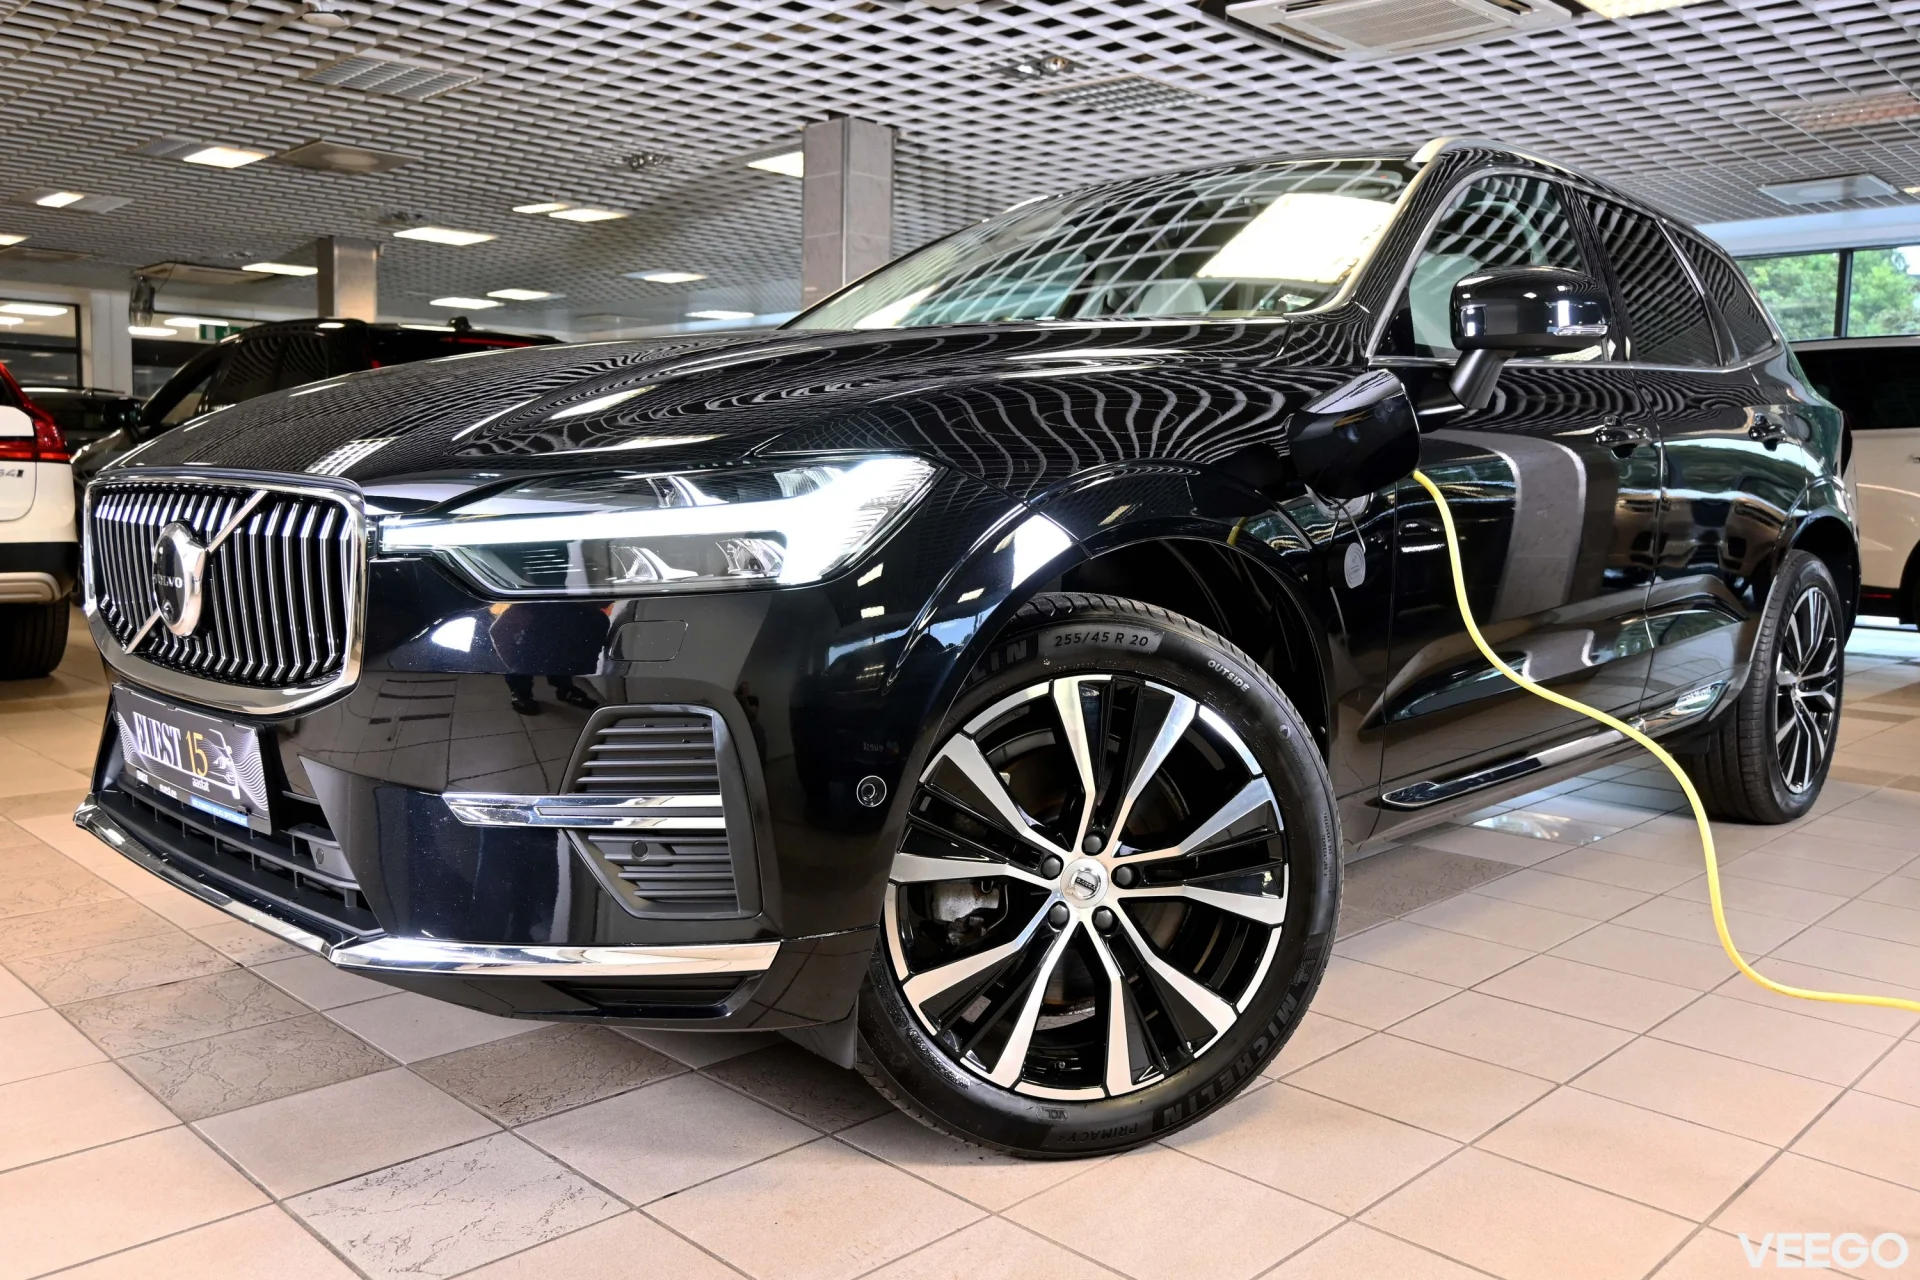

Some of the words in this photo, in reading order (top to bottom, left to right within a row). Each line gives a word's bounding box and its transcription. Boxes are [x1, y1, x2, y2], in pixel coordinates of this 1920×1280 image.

[1055, 631, 1110, 647] 255/45
[1114, 632, 1125, 644] R
[1129, 634, 1149, 647] 20
[1207, 660, 1250, 692] OUTSIDE
[185, 730, 208, 777] 15
[1163, 992, 1298, 1127] MICHELIN
[1066, 1123, 1138, 1143] PRIMACY
